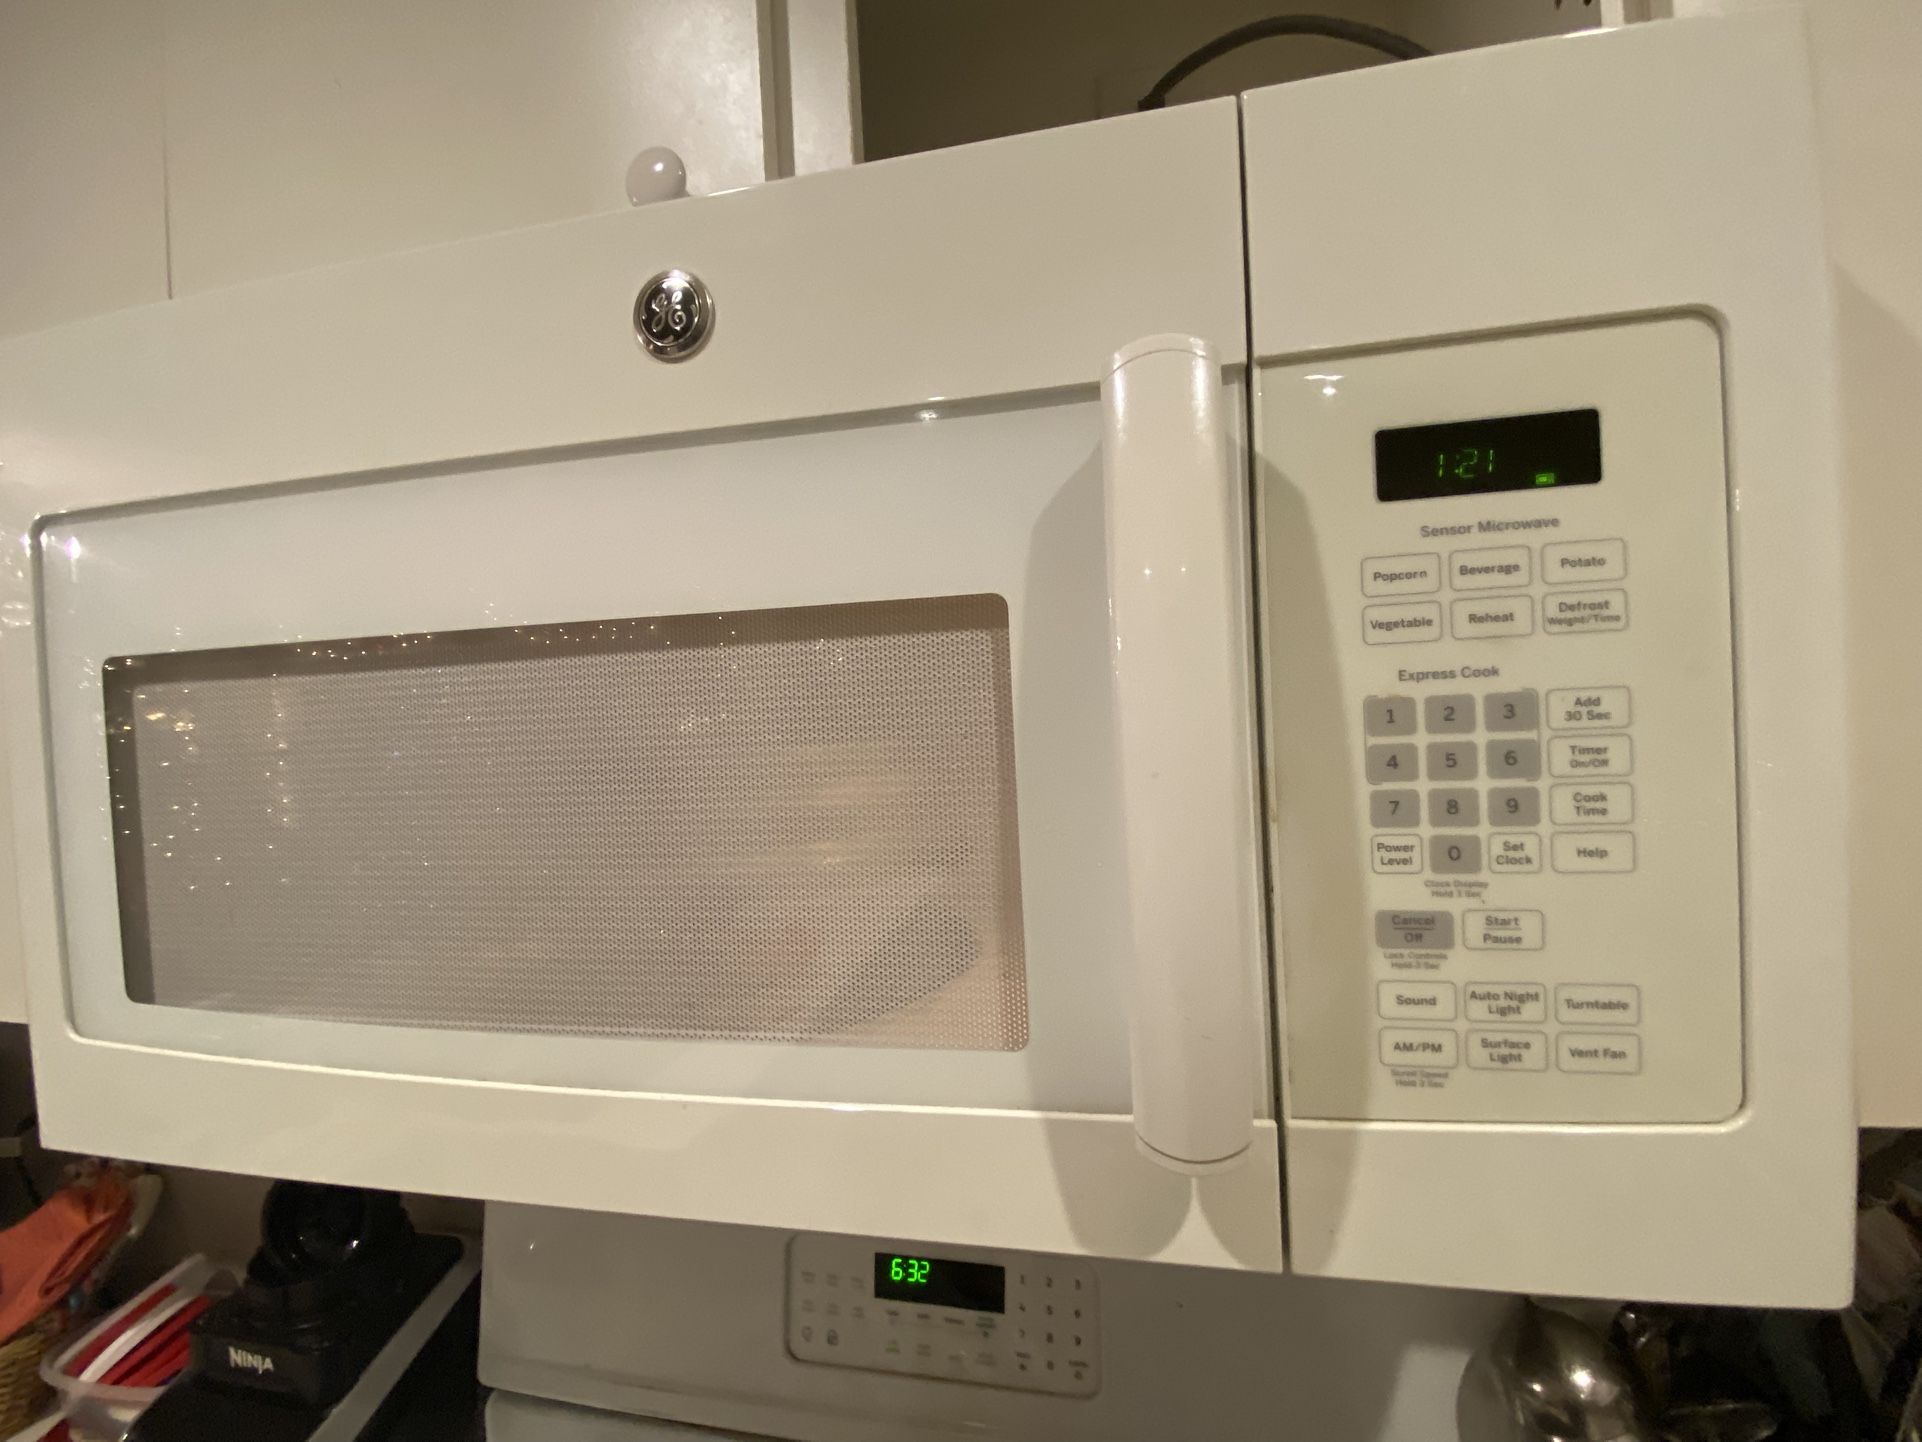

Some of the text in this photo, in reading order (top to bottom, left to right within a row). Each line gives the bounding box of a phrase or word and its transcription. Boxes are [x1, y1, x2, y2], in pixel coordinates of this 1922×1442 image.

[1438, 449, 1495, 479] 1:21
[1420, 516, 1561, 538] Sensor Microwave
[1560, 555, 1607, 569] Potato
[1373, 569, 1428, 583] Popcorn
[1459, 562, 1521, 577] Beverage
[1558, 600, 1610, 613] Defrost
[1369, 616, 1434, 632] Vegetable
[1468, 611, 1515, 625] Reheat
[1398, 665, 1500, 683] Express Cook
[1573, 696, 1602, 708] Add
[1386, 708, 1396, 724] 1
[1443, 705, 1456, 722] 2
[1502, 703, 1517, 720] 3
[1563, 709, 1612, 722] 30 Sec
[1569, 744, 1609, 756] Timer
[1386, 754, 1400, 770] 4
[1445, 752, 1458, 768] 5
[1504, 750, 1518, 766] 6
[1573, 791, 1608, 803] Cook
[1388, 800, 1401, 816] 7
[1446, 798, 1460, 816] 8
[1505, 797, 1520, 814] 9
[1575, 803, 1609, 816] Time
[1376, 841, 1416, 855] Power
[1447, 845, 1462, 862] 0
[1502, 840, 1525, 853] Set
[1576, 846, 1608, 860] Help
[1380, 854, 1413, 867] Level
[1495, 853, 1533, 866] Clock
[1391, 914, 1435, 926] Cancel
[1485, 915, 1521, 927] Start
[1403, 932, 1424, 943] Off
[1482, 932, 1523, 945] Pause
[1395, 994, 1438, 1007] Sound
[1469, 990, 1541, 1005] Auto Night
[1488, 1004, 1522, 1018] Light
[1565, 999, 1630, 1011] Turntable
[1393, 1041, 1444, 1054] AM/PM
[1480, 1037, 1532, 1051] Surface
[1489, 1052, 1523, 1066] Light
[1568, 1047, 1628, 1060] Vent Fan
[890, 1257, 930, 1283] 6:32
[228, 1345, 275, 1376] NINJA
